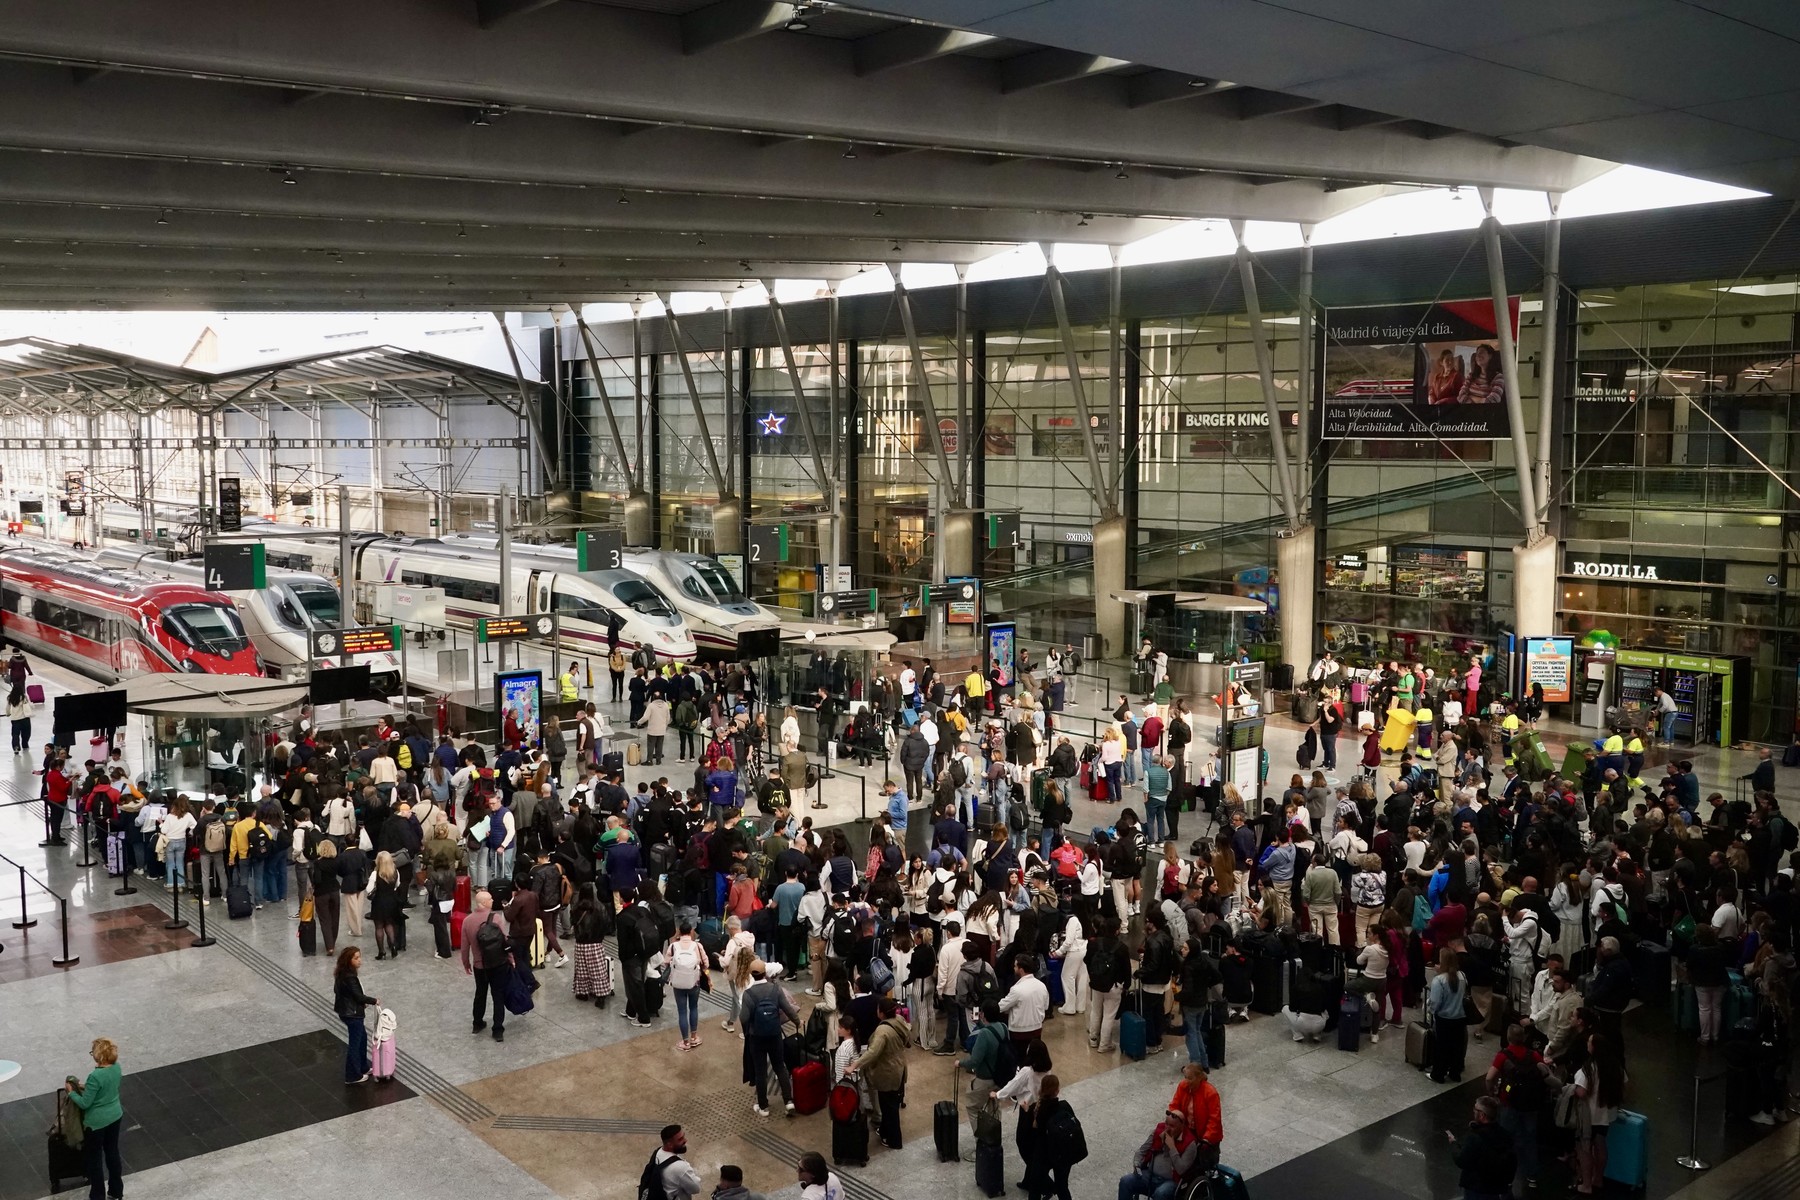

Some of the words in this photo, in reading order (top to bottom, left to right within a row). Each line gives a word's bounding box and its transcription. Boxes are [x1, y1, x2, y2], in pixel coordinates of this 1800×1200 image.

[1330, 325, 1369, 340] Madrid
[1371, 326, 1379, 338] 6
[1382, 325, 1415, 340] viajes
[1417, 323, 1429, 336] al
[1431, 322, 1453, 335] día.
[1605, 388, 1628, 402] KING
[1185, 413, 1236, 427] BURGER
[1237, 412, 1270, 427] KING
[1328, 409, 1346, 418] Alta
[1348, 408, 1393, 418] Velocidad.
[1328, 423, 1346, 432] Alta
[1347, 422, 1405, 433] Flexibilidad.
[1408, 423, 1428, 433] Alta
[1429, 422, 1489, 433] Comodidad.
[1011, 530, 1019, 546] 1
[610, 550, 620, 568] 3
[751, 544, 761, 562] 2
[209, 568, 224, 589] 4
[1573, 561, 1658, 580] RODILLA
[504, 680, 537, 689] Almagro
